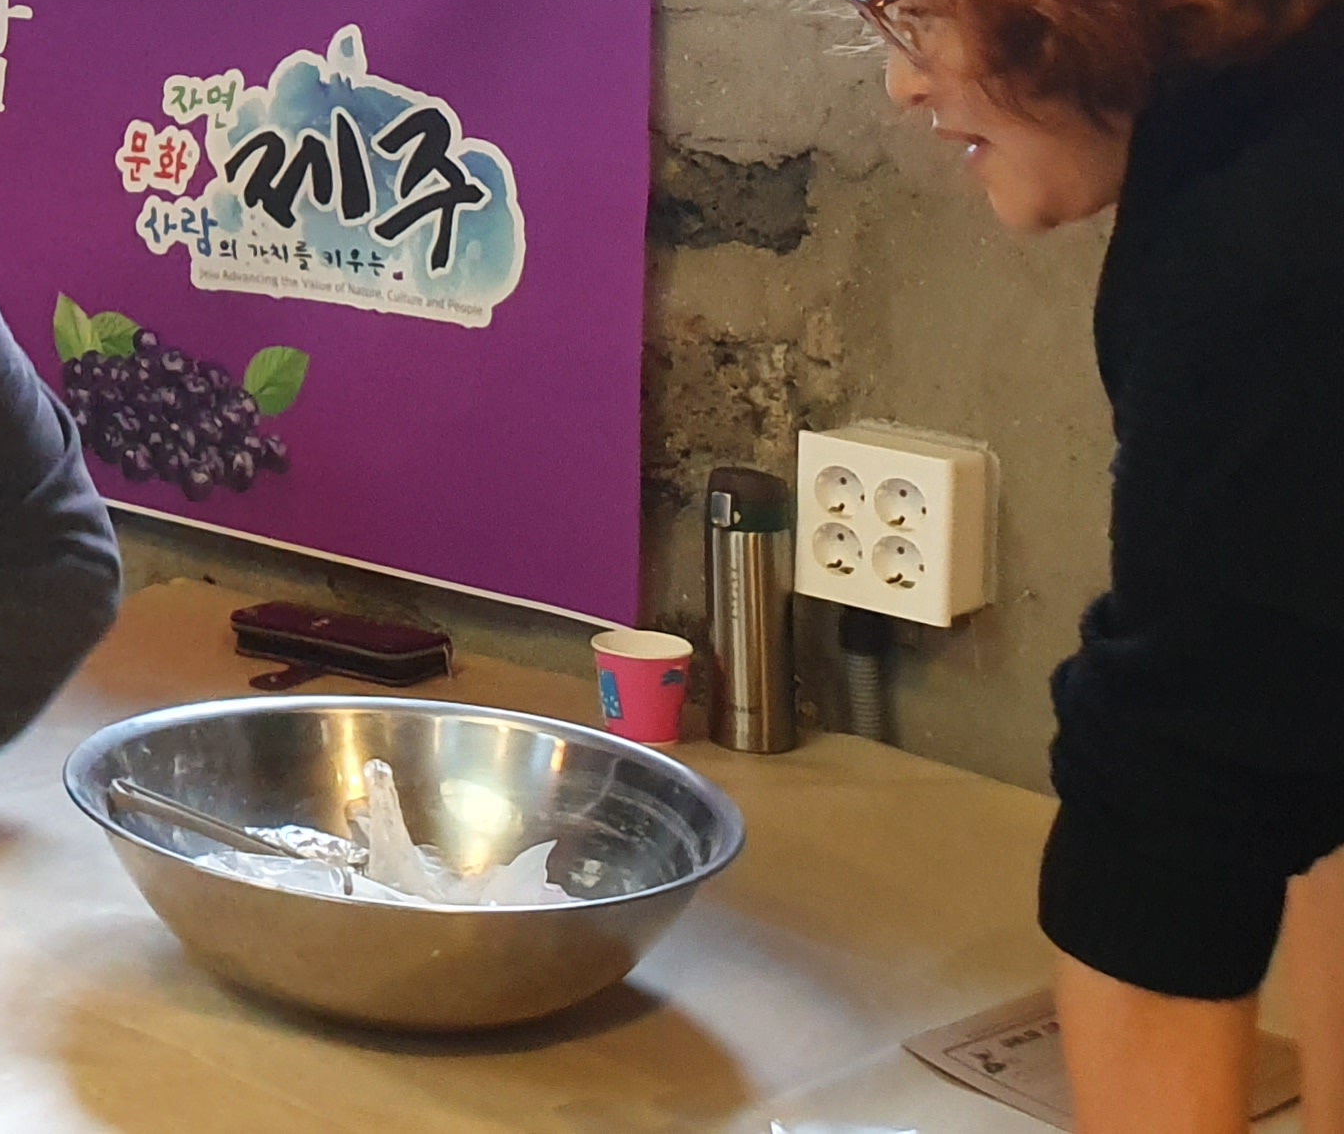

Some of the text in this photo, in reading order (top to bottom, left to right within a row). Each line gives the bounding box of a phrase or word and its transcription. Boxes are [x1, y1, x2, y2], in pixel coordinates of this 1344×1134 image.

[170, 80, 237, 129] 자연
[123, 130, 187, 184] 문화
[224, 107, 485, 270] 제주
[247, 240, 312, 271] 가치를
[323, 248, 386, 277] 키우는
[222, 269, 279, 289] Advancing
[280, 276, 299, 287] the
[301, 277, 331, 291] Value
[334, 282, 345, 292] of
[386, 290, 424, 307] Culture
[426, 298, 445, 310] and
[447, 299, 483, 316] People
